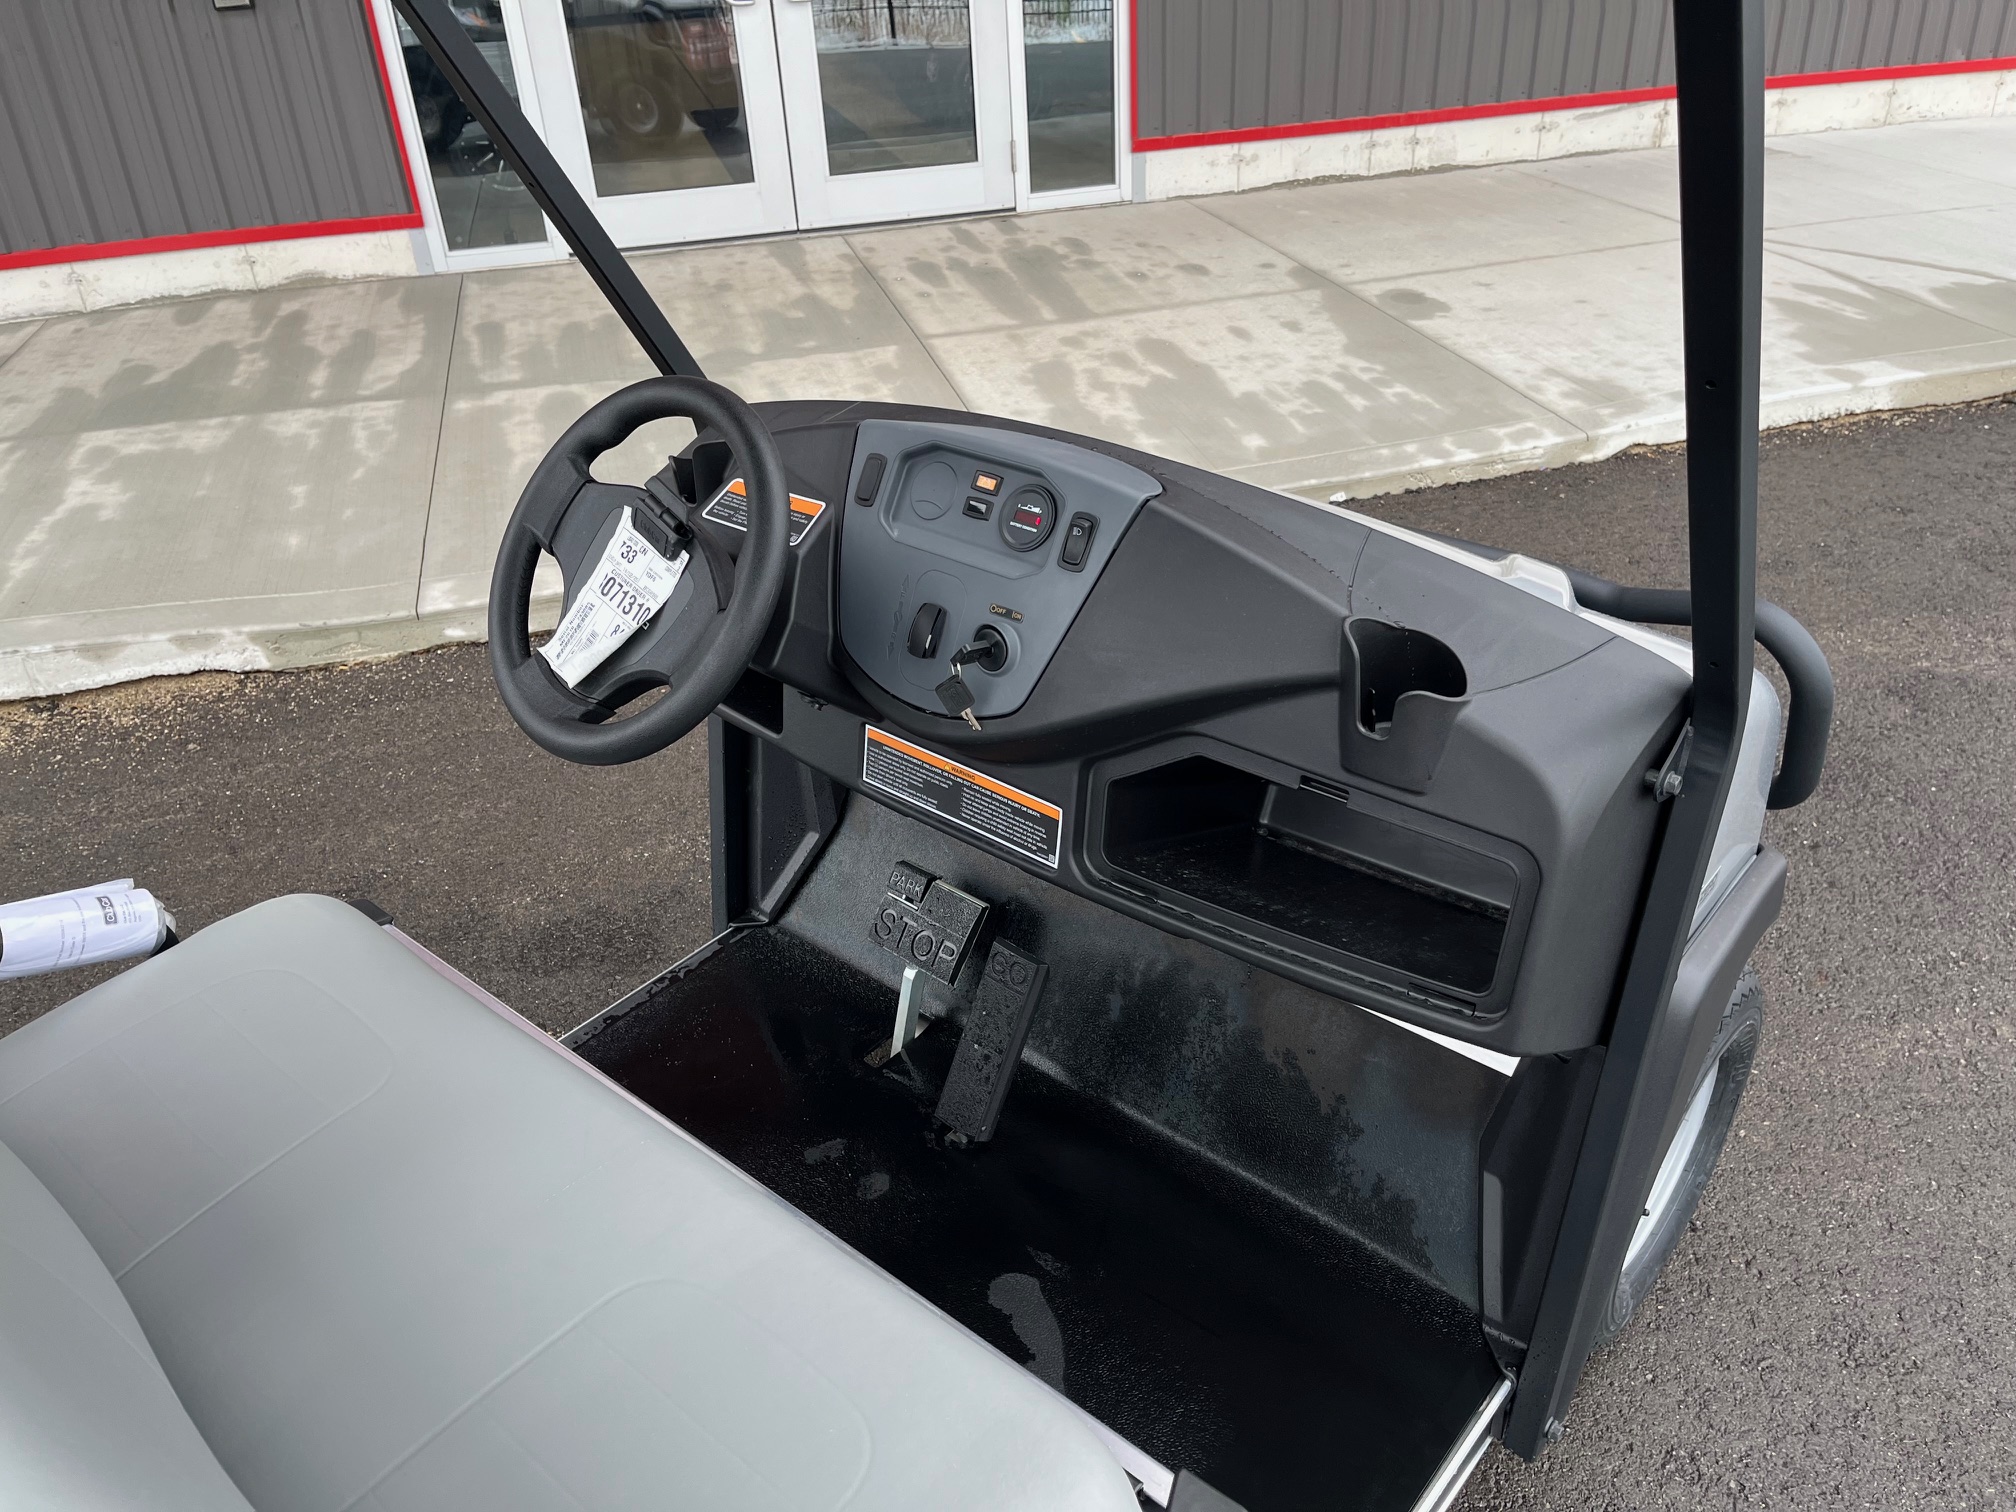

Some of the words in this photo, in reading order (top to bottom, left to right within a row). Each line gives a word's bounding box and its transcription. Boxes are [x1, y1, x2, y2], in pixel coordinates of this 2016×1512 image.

[951, 765, 975, 781] WARNING
[890, 871, 923, 897] PARK
[875, 908, 957, 967] STOP
[992, 952, 1026, 985] GO
